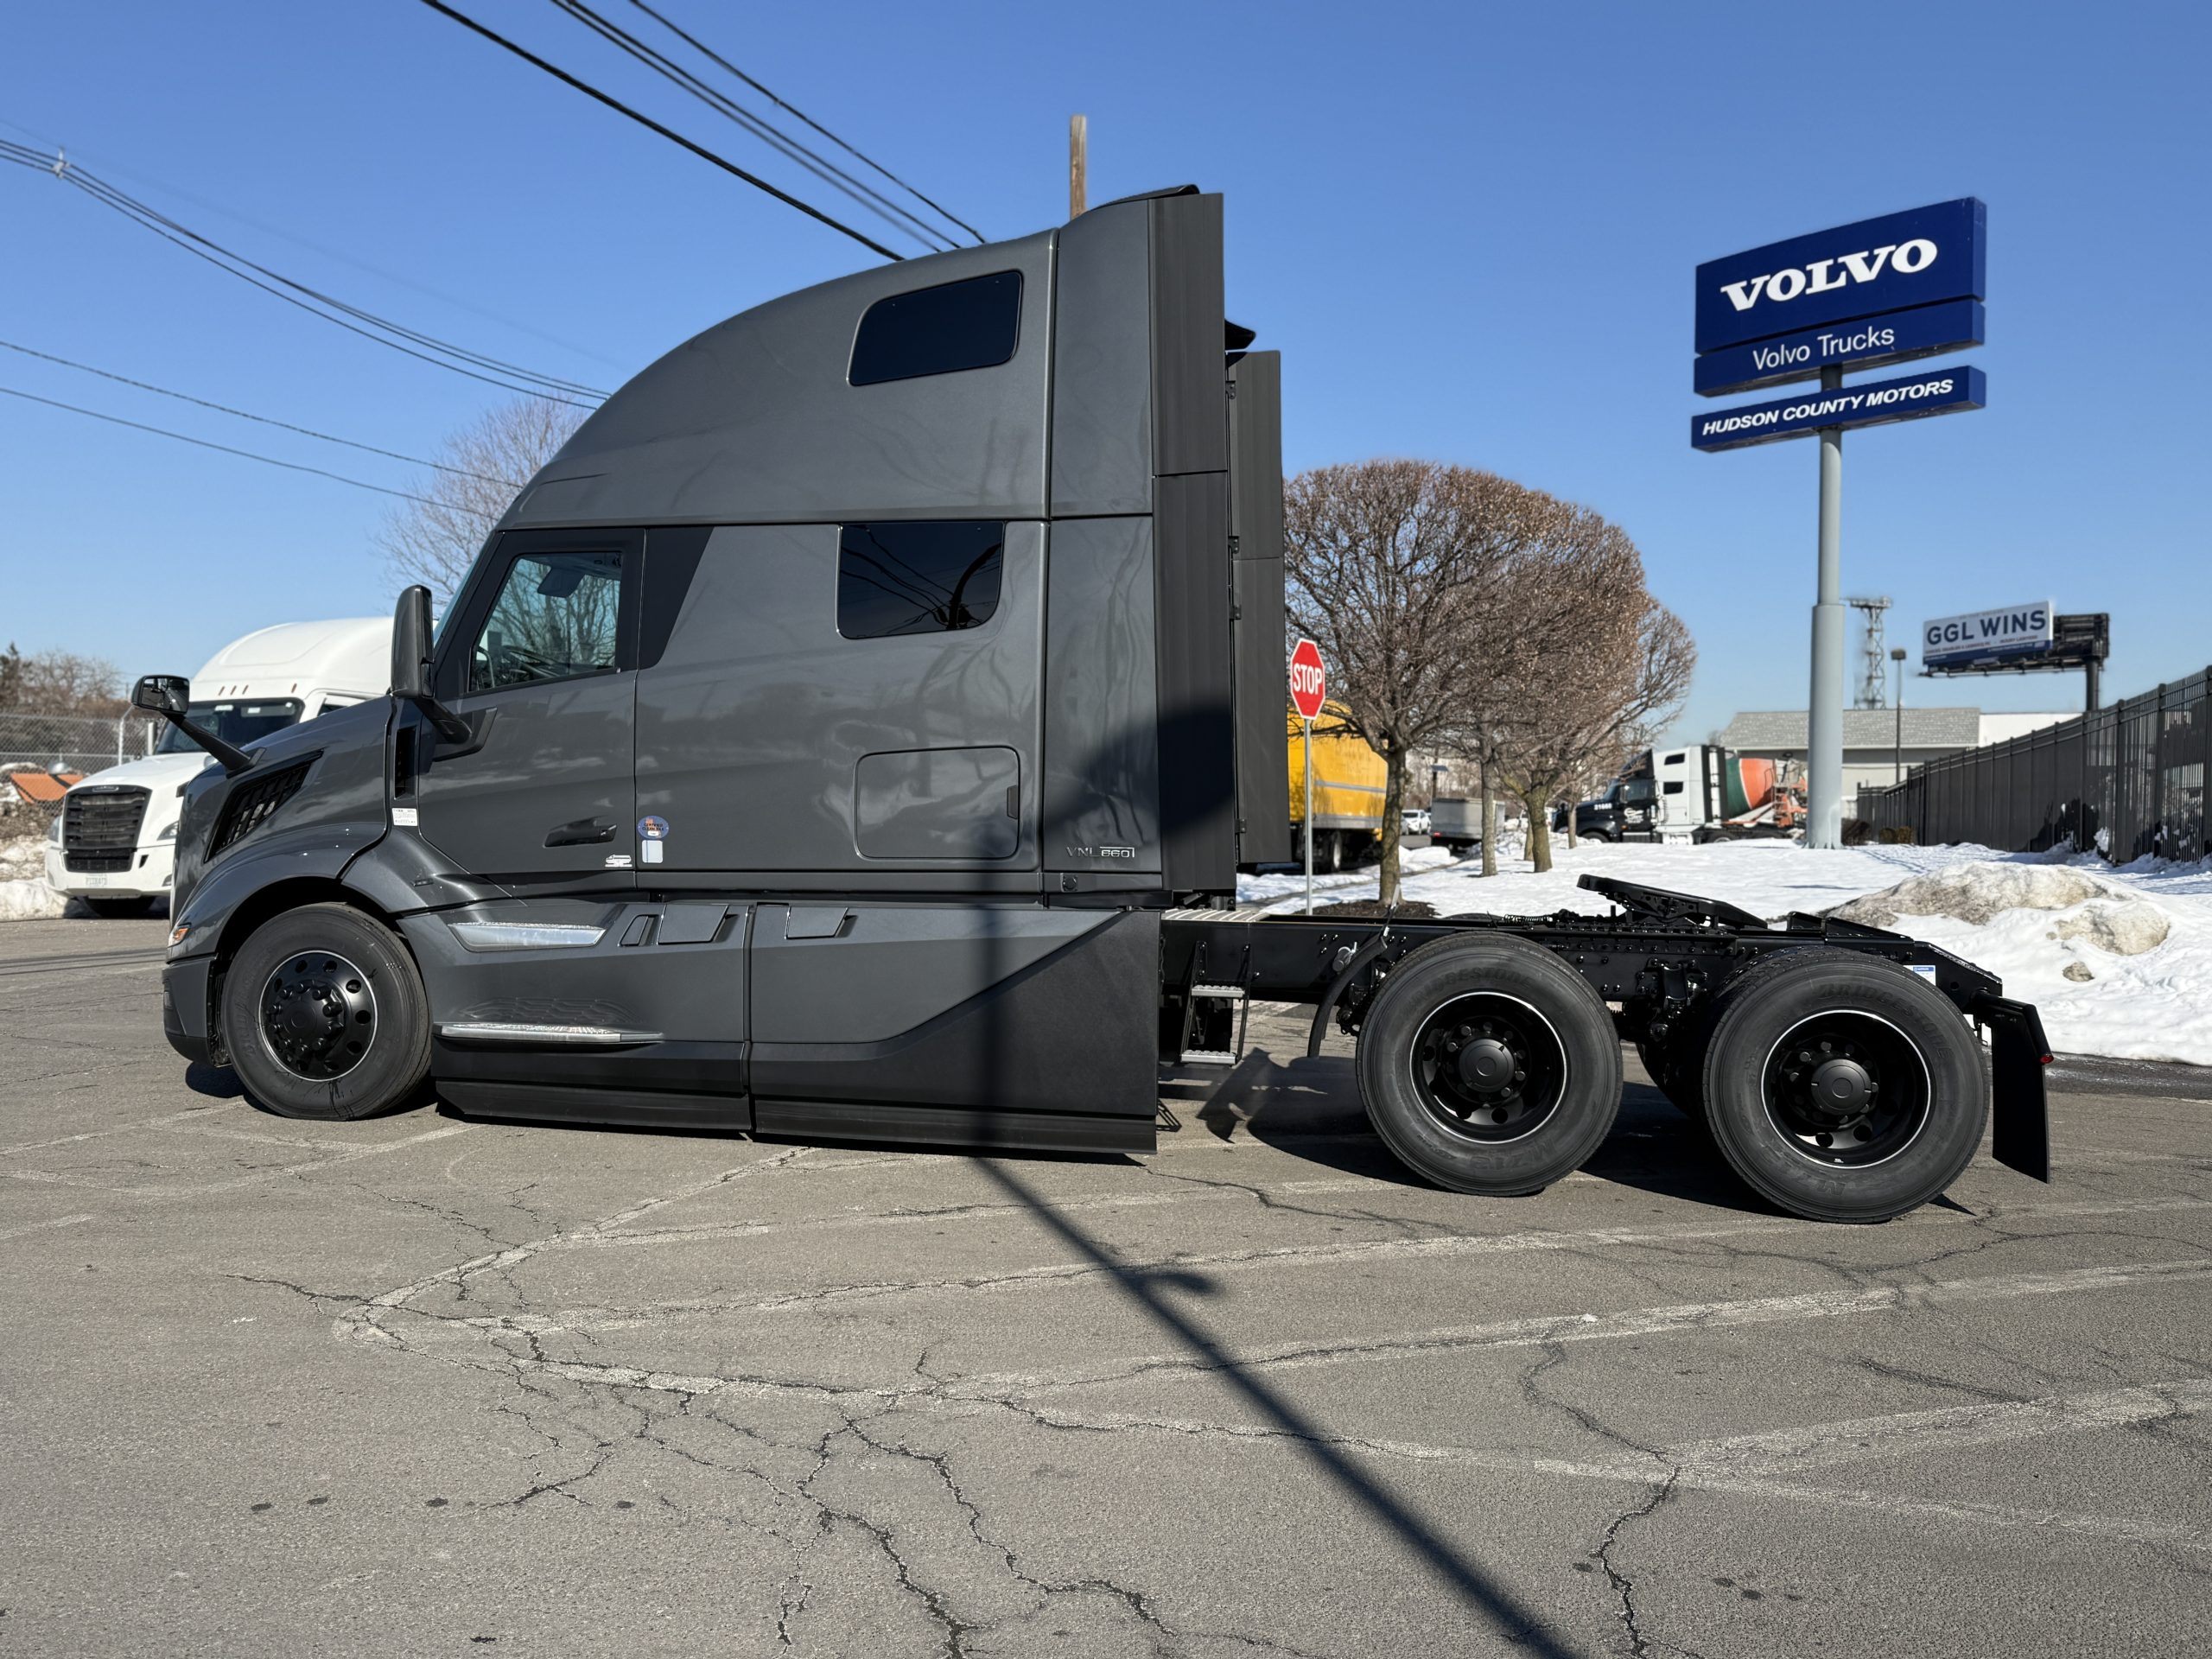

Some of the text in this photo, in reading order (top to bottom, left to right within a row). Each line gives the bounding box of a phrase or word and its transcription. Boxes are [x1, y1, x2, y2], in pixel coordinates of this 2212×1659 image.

[1720, 238, 1937, 311] VOLVO
[1753, 326, 1895, 370] Volvo Trucks
[1702, 378, 1955, 435] HUDSON COUNTY MOTORS
[1927, 622, 1974, 645] GGL
[1980, 610, 2046, 637] WINS
[1293, 663, 1323, 695] STOP
[1066, 846, 1100, 857] VNL
